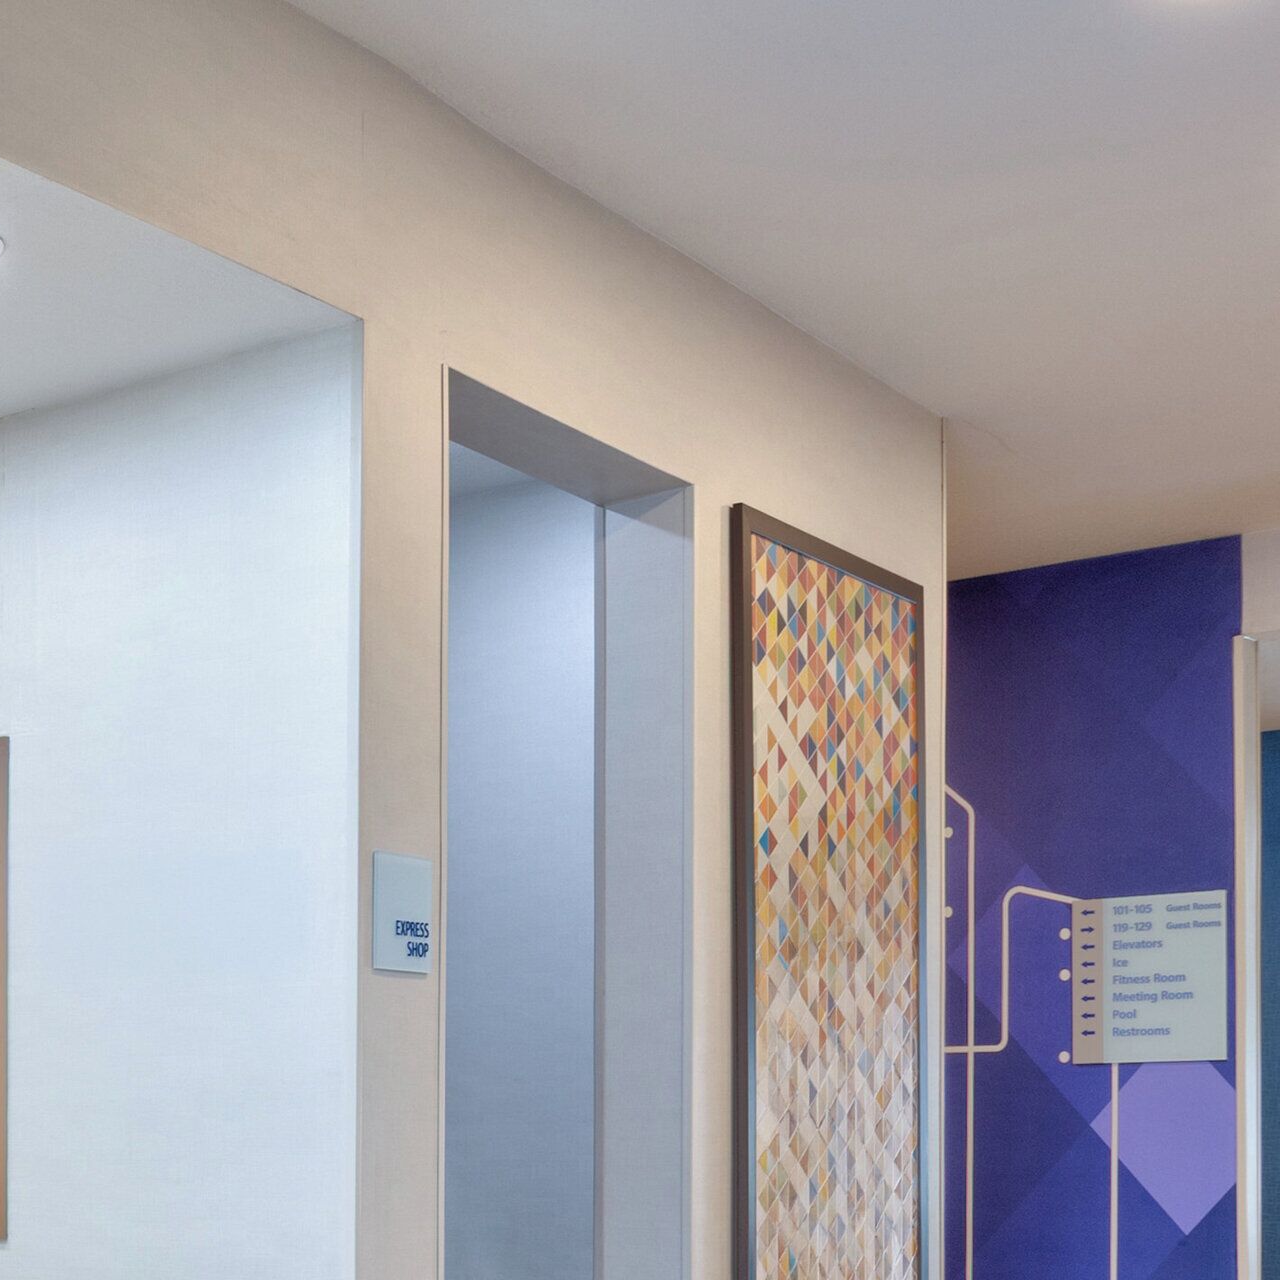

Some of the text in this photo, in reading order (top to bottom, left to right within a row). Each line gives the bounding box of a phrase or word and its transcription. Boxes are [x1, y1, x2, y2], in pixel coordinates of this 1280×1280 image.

[1113, 904, 1152, 915] 101-105
[1166, 904, 1190, 912] Guest
[395, 920, 429, 938] EXPRESS
[1113, 921, 1152, 932] 119-129
[1193, 920, 1221, 928] Rooms
[407, 941, 429, 957] SHOP
[1112, 940, 1163, 950] Elevators
[1112, 957, 1128, 968] Ice
[1112, 973, 1186, 985] Fitness Room
[1112, 990, 1194, 1003] Meeting Room
[1112, 1009, 1137, 1019] Pool
[1112, 1026, 1171, 1037] Restrooms
